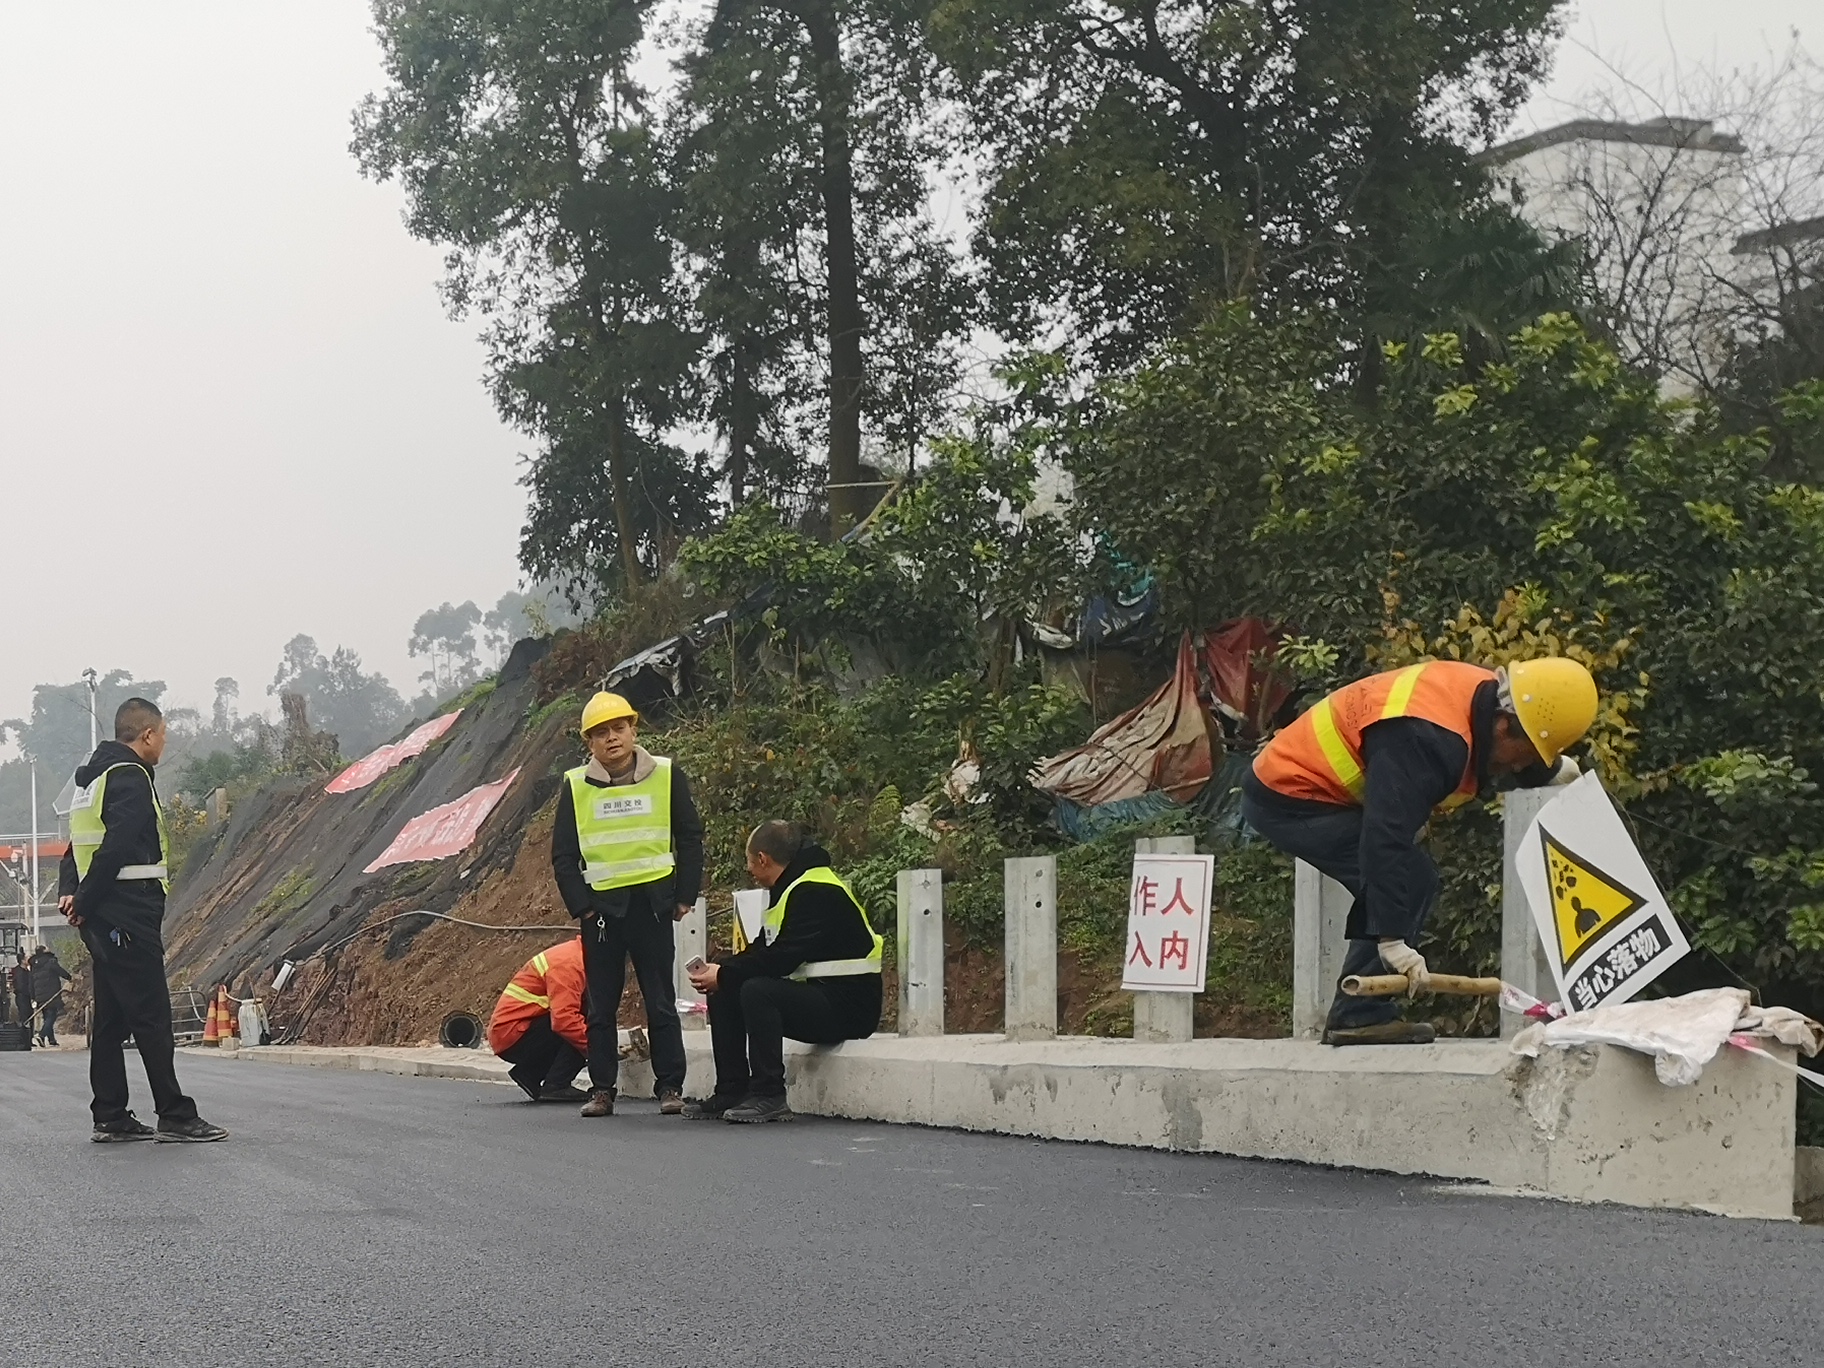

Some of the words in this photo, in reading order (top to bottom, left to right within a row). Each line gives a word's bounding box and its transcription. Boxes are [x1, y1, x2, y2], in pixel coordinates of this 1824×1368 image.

[1134, 875, 1194, 916] 作人
[1129, 930, 1189, 970] 入内
[1575, 927, 1662, 1010] 当心落物
